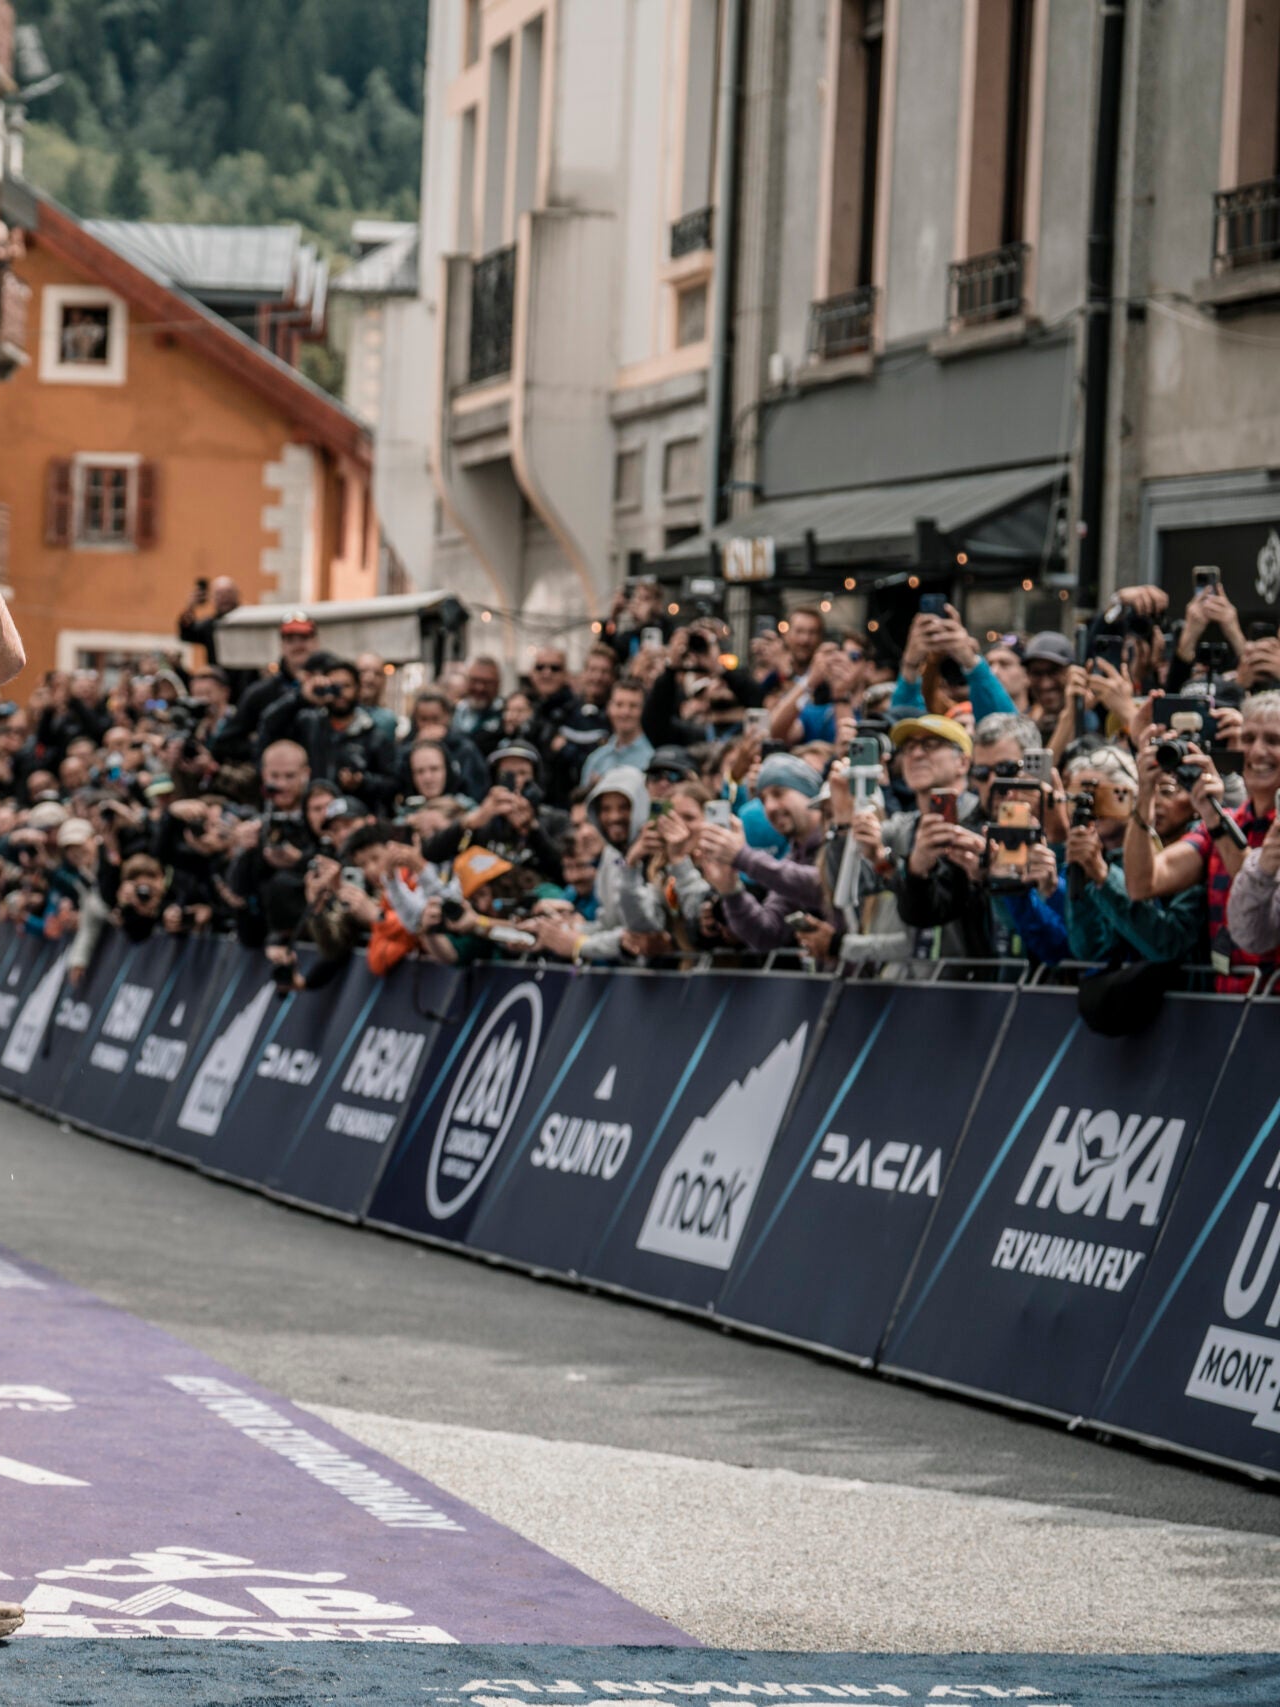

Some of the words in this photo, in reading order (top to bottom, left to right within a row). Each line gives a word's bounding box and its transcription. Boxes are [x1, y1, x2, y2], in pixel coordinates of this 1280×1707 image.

[530, 1113, 632, 1181] SUUNTO
[812, 1132, 942, 1198] DACIA
[1016, 1106, 1186, 1226] HOKA
[1093, 1246, 1145, 1292] FLY
[1198, 1344, 1280, 1412] MONT-
[594, 1680, 910, 1697] HUMAN
